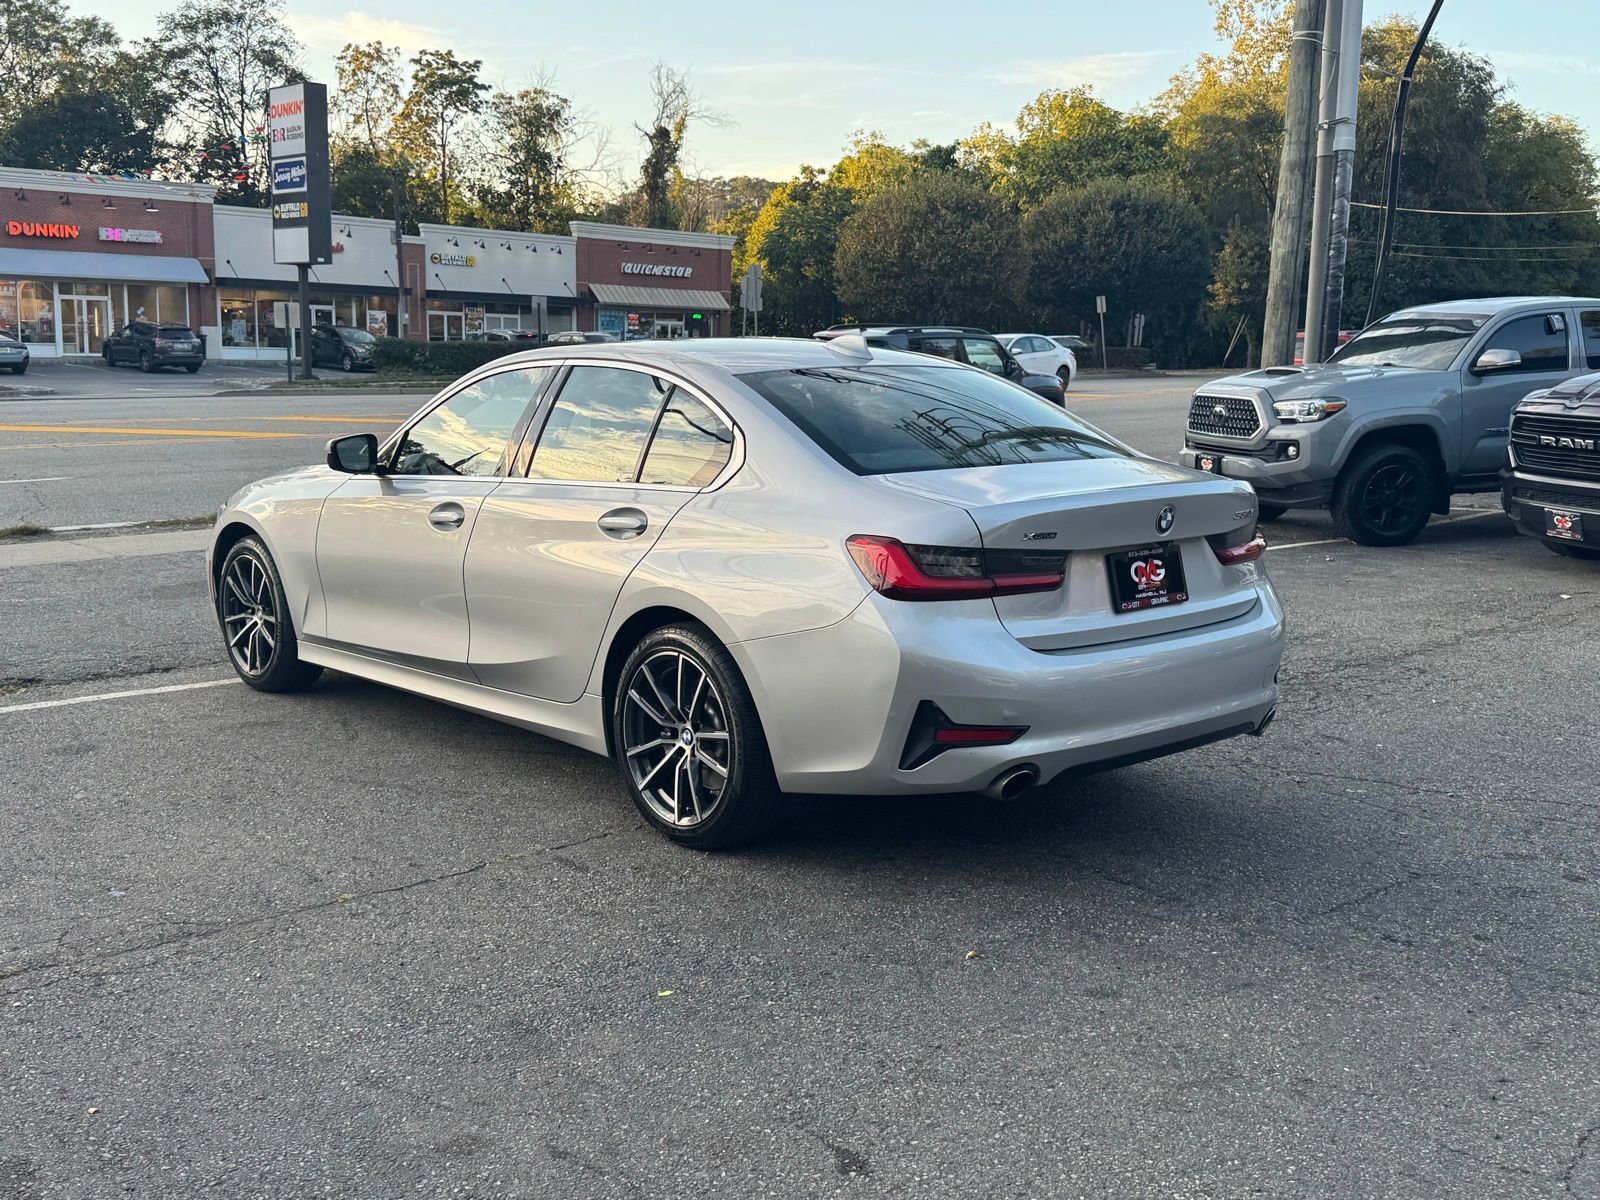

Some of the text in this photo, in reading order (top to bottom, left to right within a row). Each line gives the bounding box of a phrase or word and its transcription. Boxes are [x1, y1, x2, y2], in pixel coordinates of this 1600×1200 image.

[271, 101, 304, 118] DUNKIN'
[6, 221, 80, 239] DUNKIN'
[1540, 435, 1594, 450] RAM
